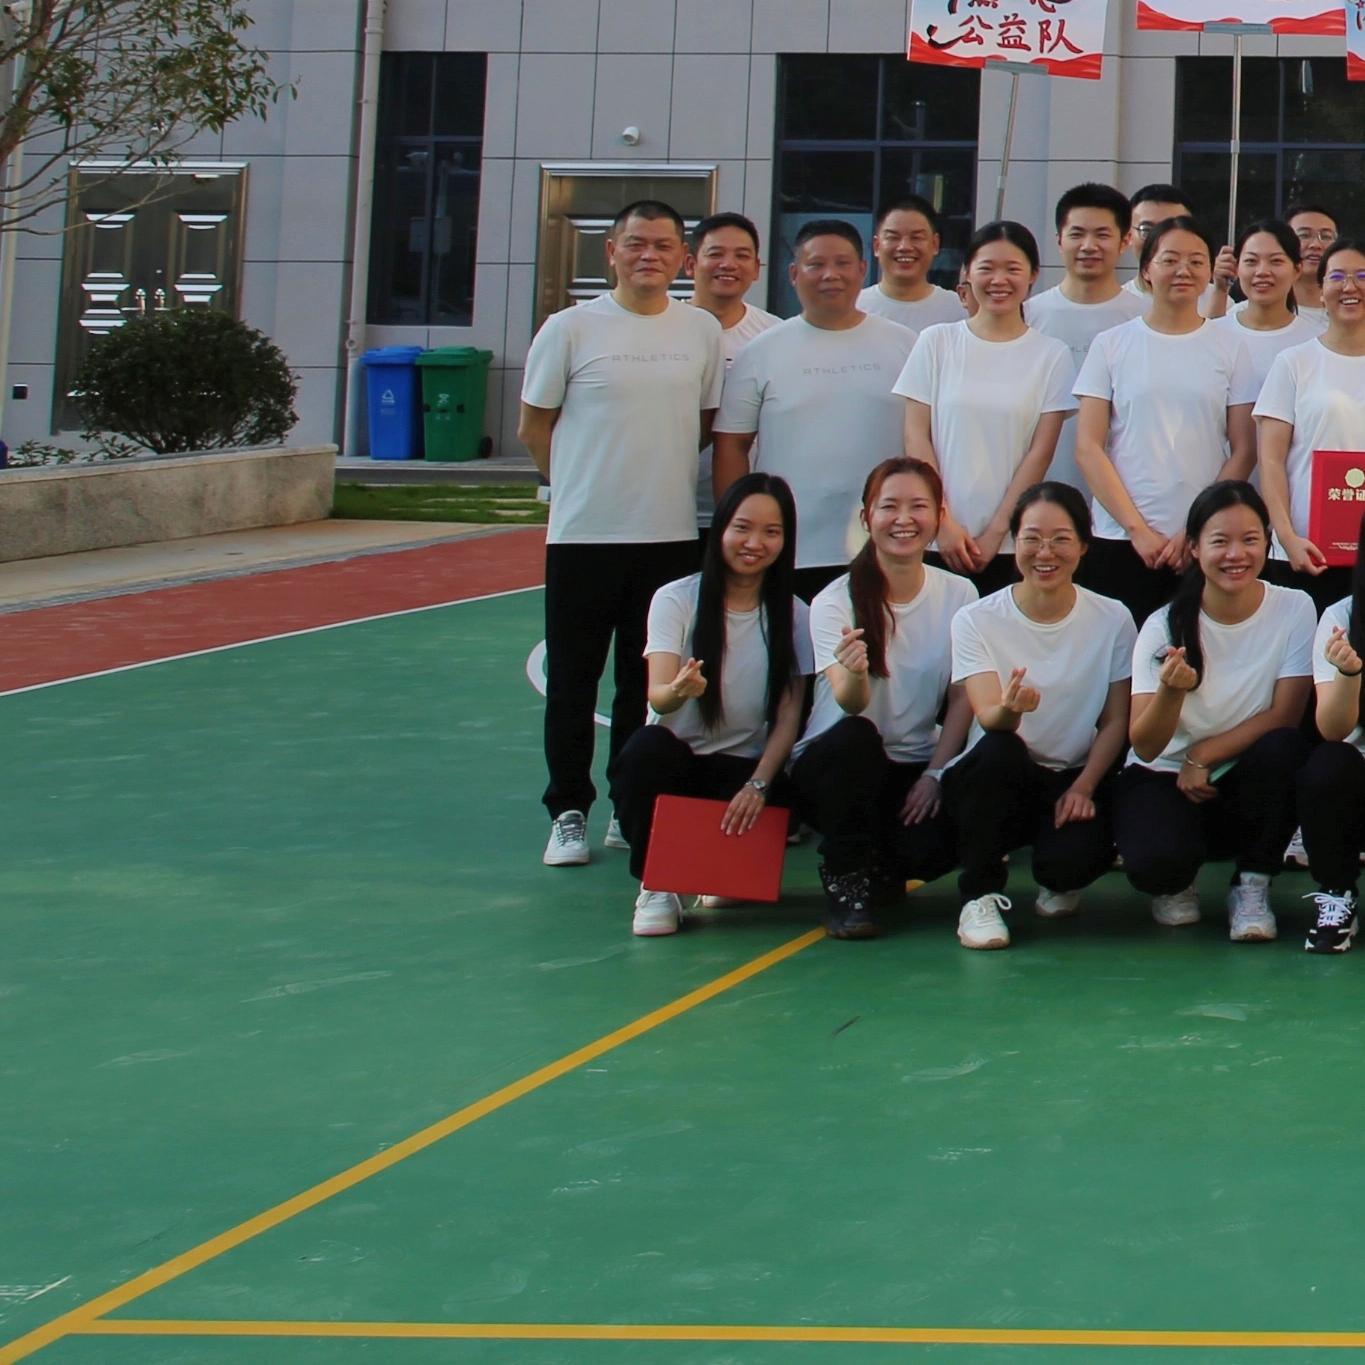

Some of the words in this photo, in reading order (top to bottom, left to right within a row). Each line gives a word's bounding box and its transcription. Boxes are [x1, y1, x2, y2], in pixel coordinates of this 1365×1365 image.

[958, 12, 1084, 55] 公益队
[612, 353, 690, 363] ATHLETICS
[803, 363, 881, 375] ATHLETICS
